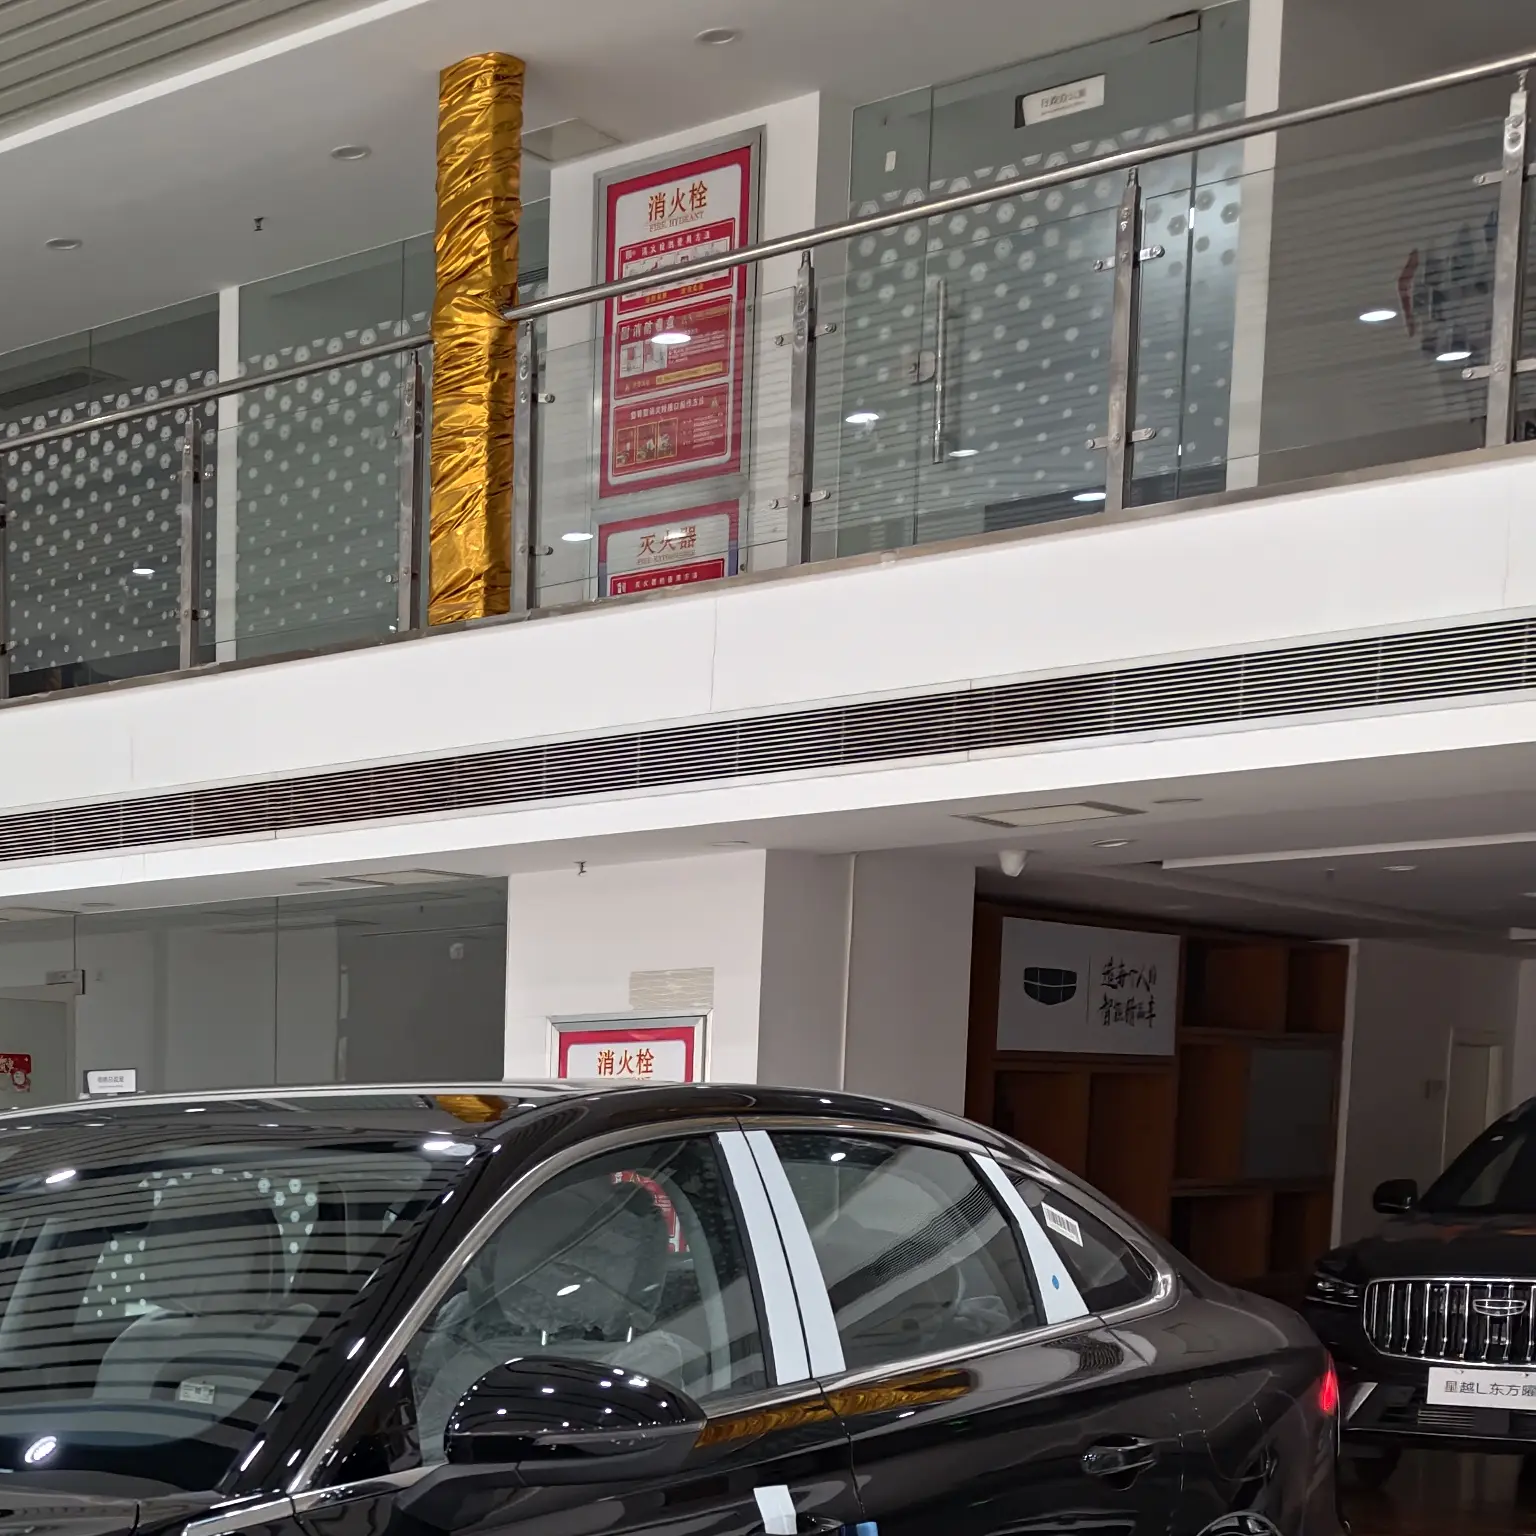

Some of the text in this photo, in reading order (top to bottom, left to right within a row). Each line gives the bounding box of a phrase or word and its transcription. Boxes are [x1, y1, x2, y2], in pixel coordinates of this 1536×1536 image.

[648, 180, 708, 222] 消火栓
[637, 525, 696, 556] 灭火器
[597, 1048, 655, 1076] 消火栓
